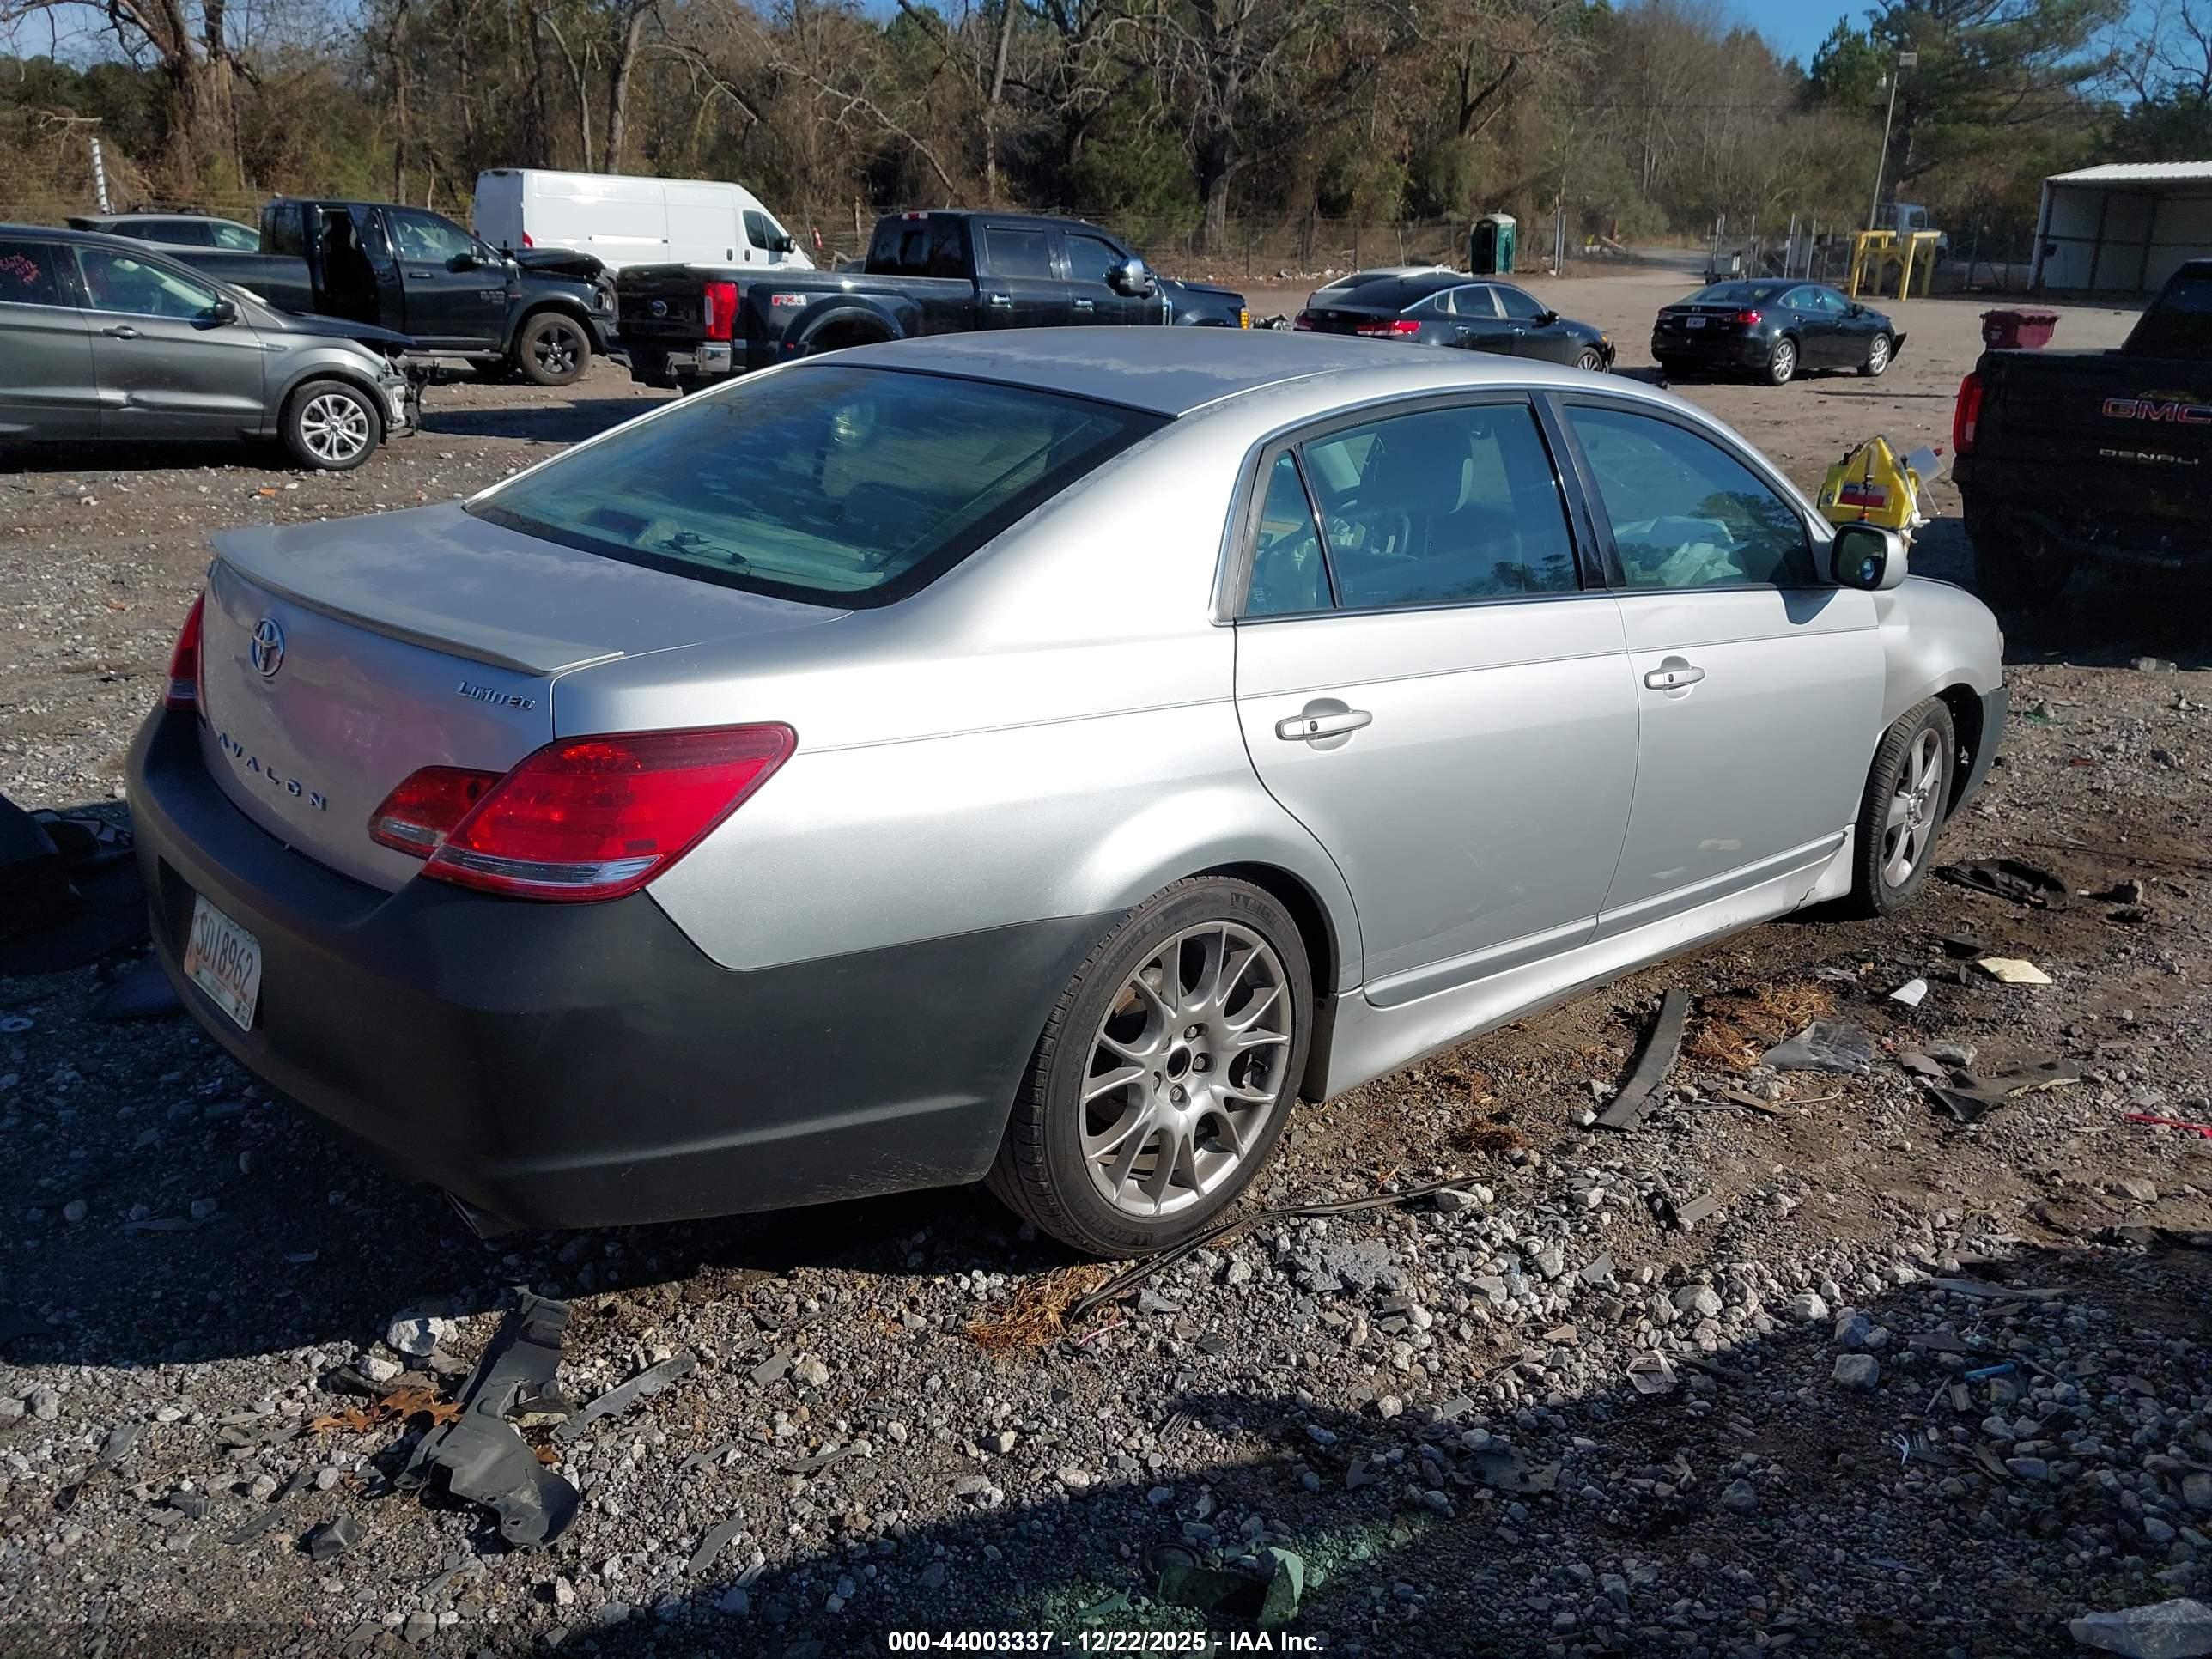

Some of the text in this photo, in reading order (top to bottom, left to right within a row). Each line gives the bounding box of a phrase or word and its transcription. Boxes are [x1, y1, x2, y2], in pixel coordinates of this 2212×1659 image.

[2101, 398, 2212, 424] GMC
[2099, 448, 2199, 465] DENALI
[219, 732, 327, 811] AVALON
